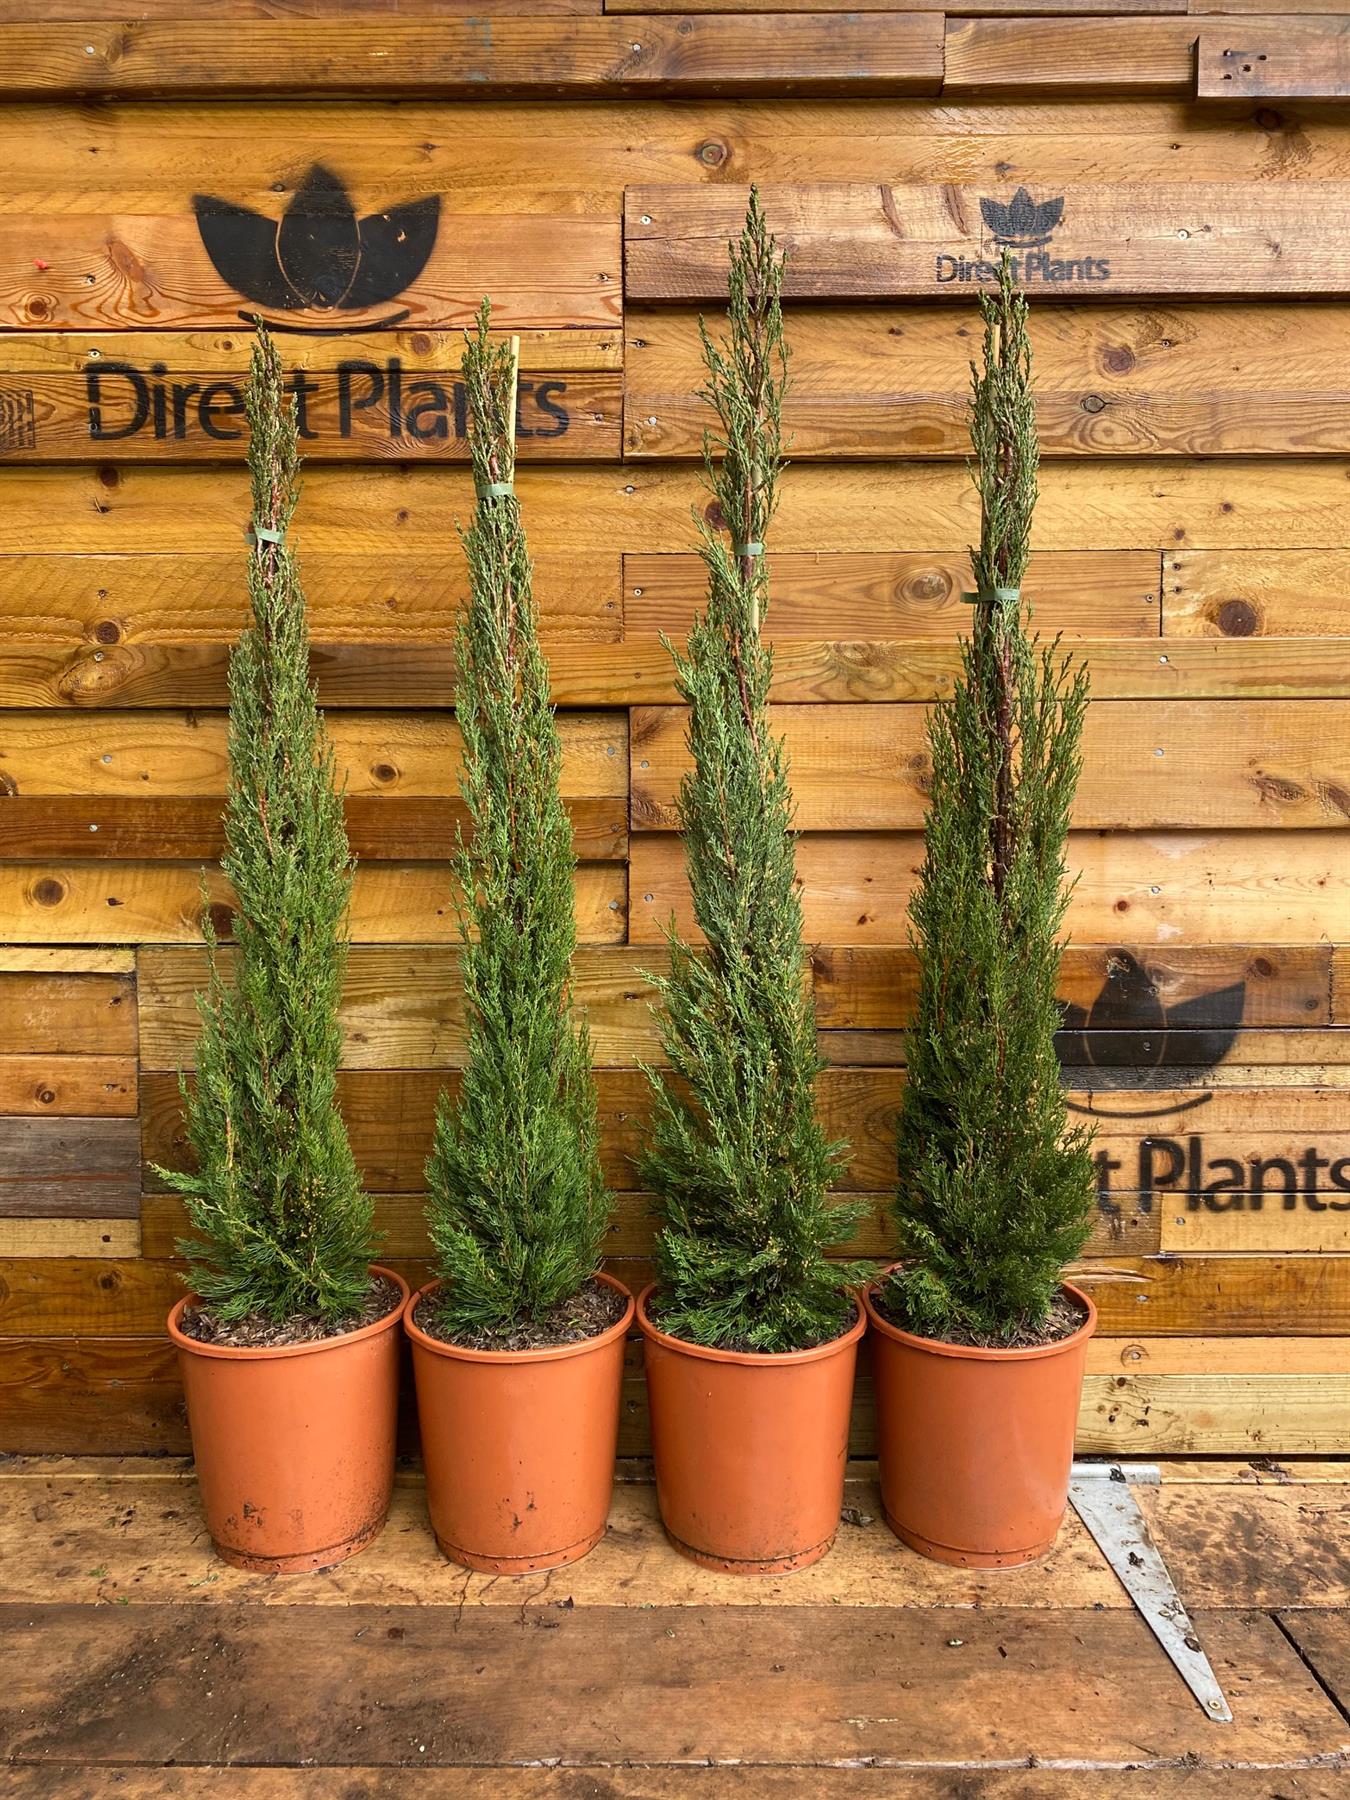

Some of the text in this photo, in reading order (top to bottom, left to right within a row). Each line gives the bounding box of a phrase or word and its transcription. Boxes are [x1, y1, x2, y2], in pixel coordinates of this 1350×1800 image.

[936, 252, 1110, 284] Diret Plants
[84, 362, 319, 440] Diret
